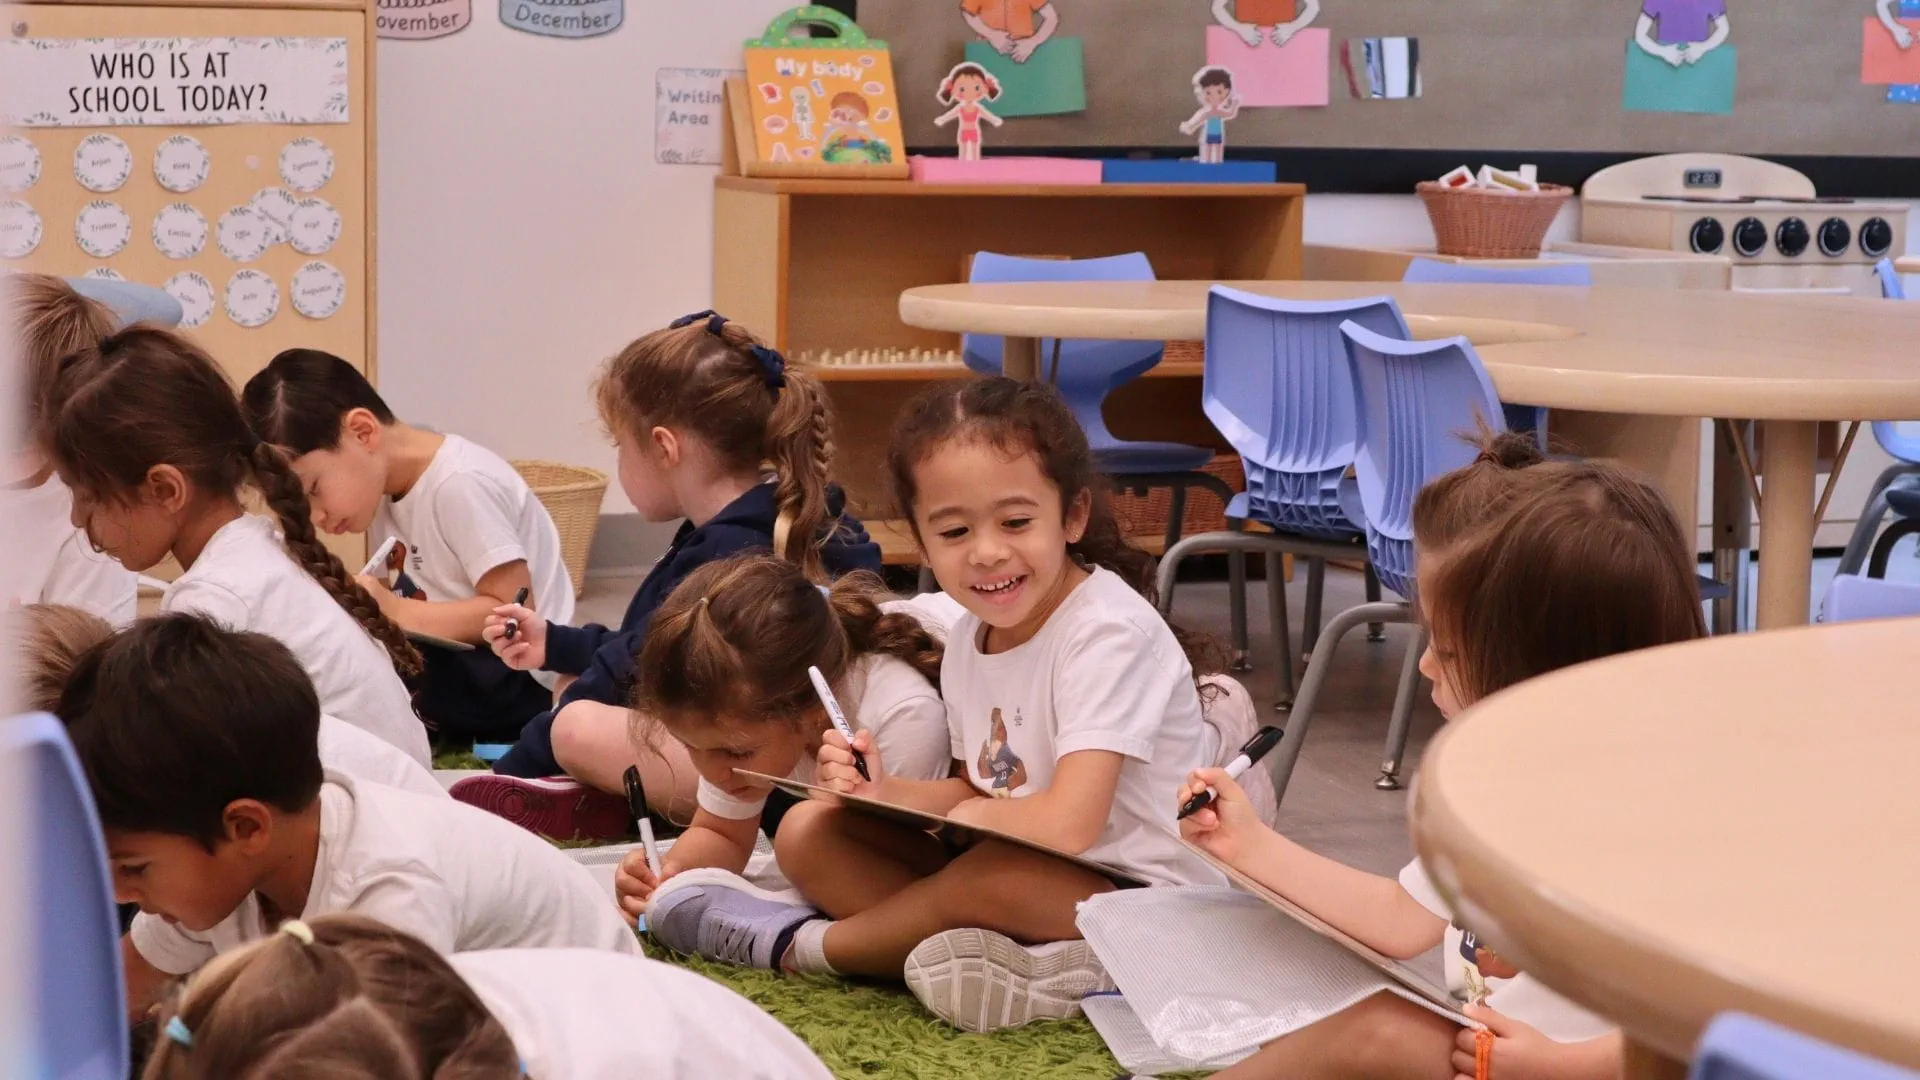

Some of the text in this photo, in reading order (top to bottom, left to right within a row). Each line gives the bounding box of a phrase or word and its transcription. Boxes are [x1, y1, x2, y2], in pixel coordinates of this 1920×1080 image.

[376, 12, 461, 32] ovember
[515, 4, 613, 30] December
[90, 52, 231, 80] WHO IS AT
[775, 57, 864, 81] My body
[69, 83, 269, 114] SCHOOL TODAY?
[667, 89, 722, 105] Writin
[667, 111, 710, 126] Area
